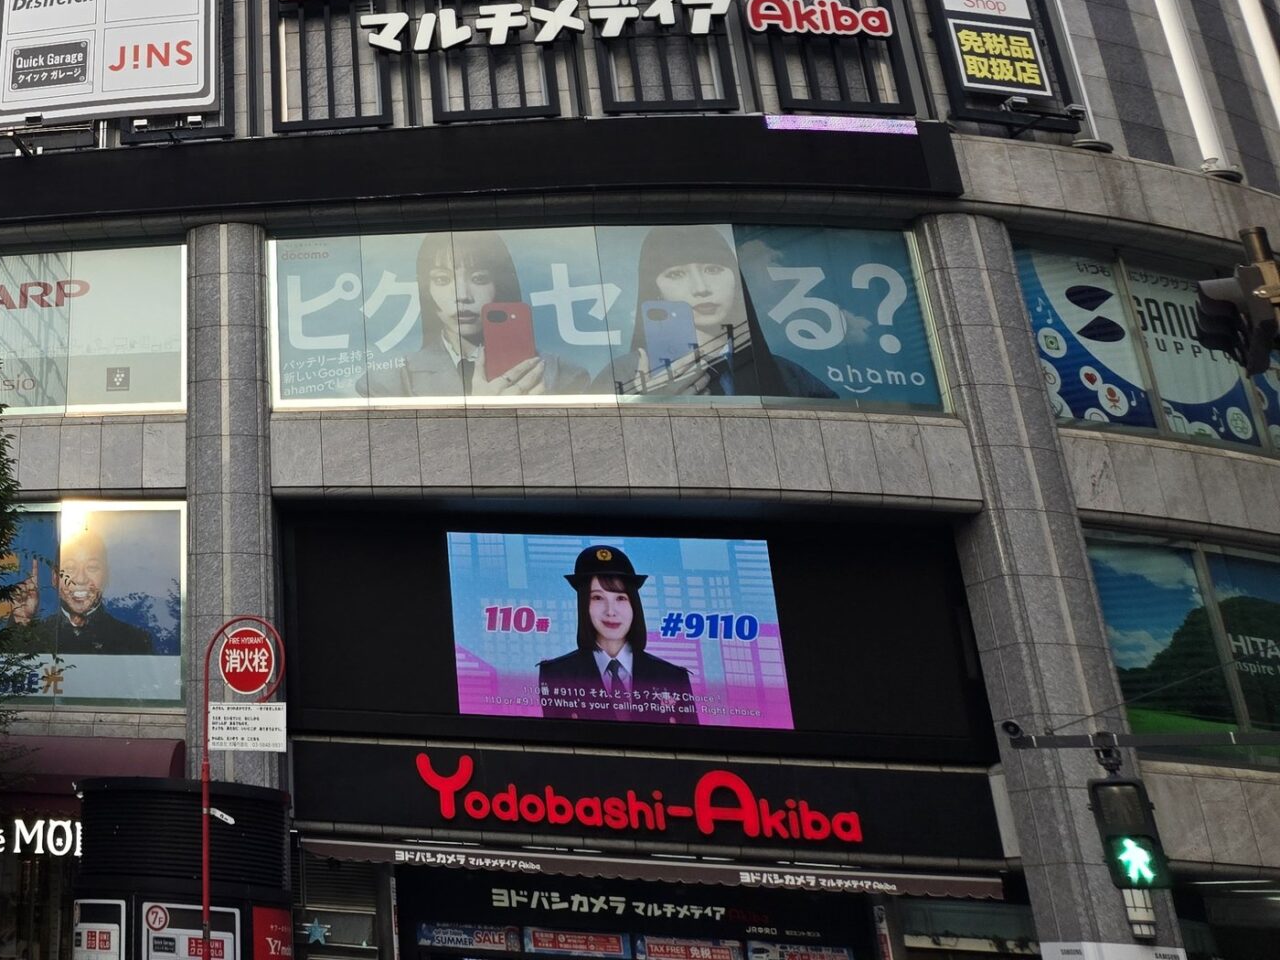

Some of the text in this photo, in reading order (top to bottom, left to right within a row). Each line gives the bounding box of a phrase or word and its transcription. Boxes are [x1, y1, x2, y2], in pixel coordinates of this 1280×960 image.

[957, 28, 1035, 60] 免税品
[15, 50, 84, 69] Quick Garage
[17, 67, 82, 84] クイック ガレージ
[964, 56, 1041, 87] 取扱店
[281, 250, 329, 260] docomo
[827, 365, 926, 386] ahamo
[485, 606, 759, 641] 110番 #9110
[229, 637, 240, 645] FIRE
[225, 648, 269, 673] 消火栓
[553, 687, 586, 698] #9110
[589, 702, 610, 712] your
[650, 703, 676, 715] Right
[701, 707, 726, 718] Right
[416, 753, 863, 842] Yodobashi-Akiba
[395, 850, 541, 871] ヨドバシカメラ マルチメディア Akiba
[739, 871, 897, 891] ヨドバシカメラ マルチメディア Akiba
[491, 887, 626, 915] ヨドバシカメラ
[632, 901, 726, 921] マルチメディア
[150, 910, 164, 926] 7F
[435, 934, 474, 948] SUMMER
[473, 930, 505, 946] SALE
[649, 944, 667, 956] TAX
[668, 945, 688, 957] FREE
[690, 945, 713, 959] 免税
